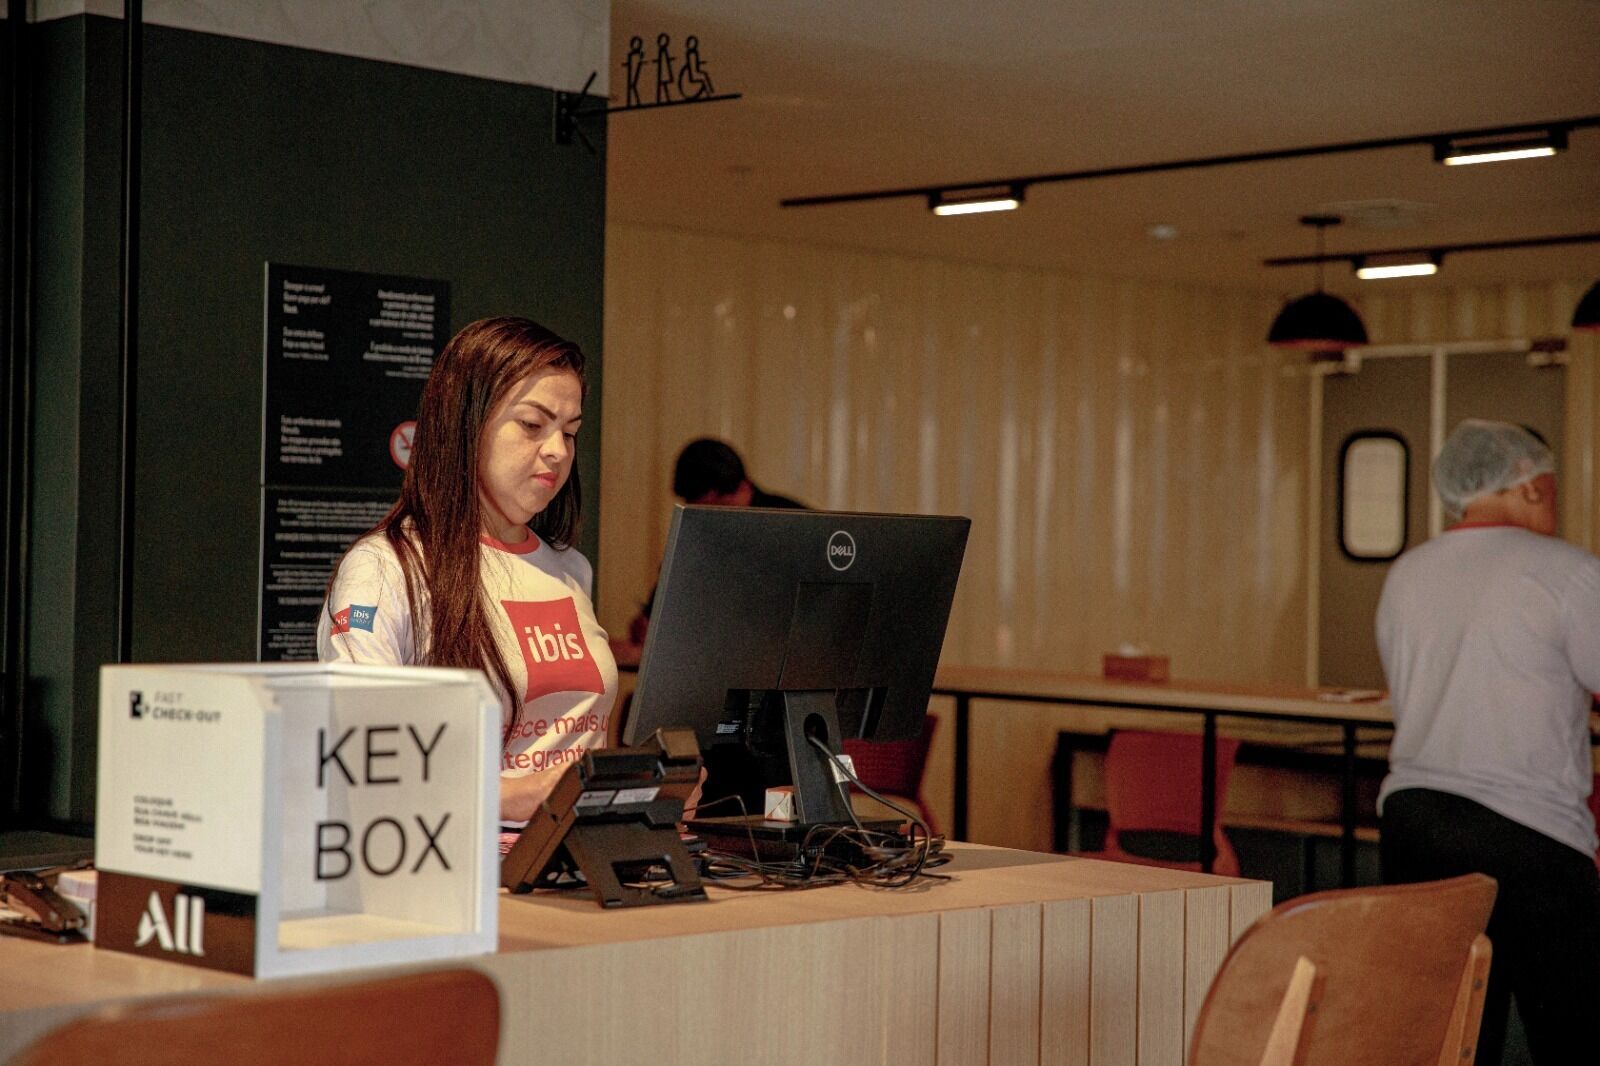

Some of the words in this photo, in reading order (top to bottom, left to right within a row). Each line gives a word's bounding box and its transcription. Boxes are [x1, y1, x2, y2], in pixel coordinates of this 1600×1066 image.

[831, 545, 853, 556] DELL
[353, 609, 370, 619] ibis
[524, 622, 585, 664] ibis
[554, 709, 599, 734] mais
[315, 722, 449, 789] KEY
[500, 744, 590, 772] tegrant
[314, 812, 453, 883] BOX
